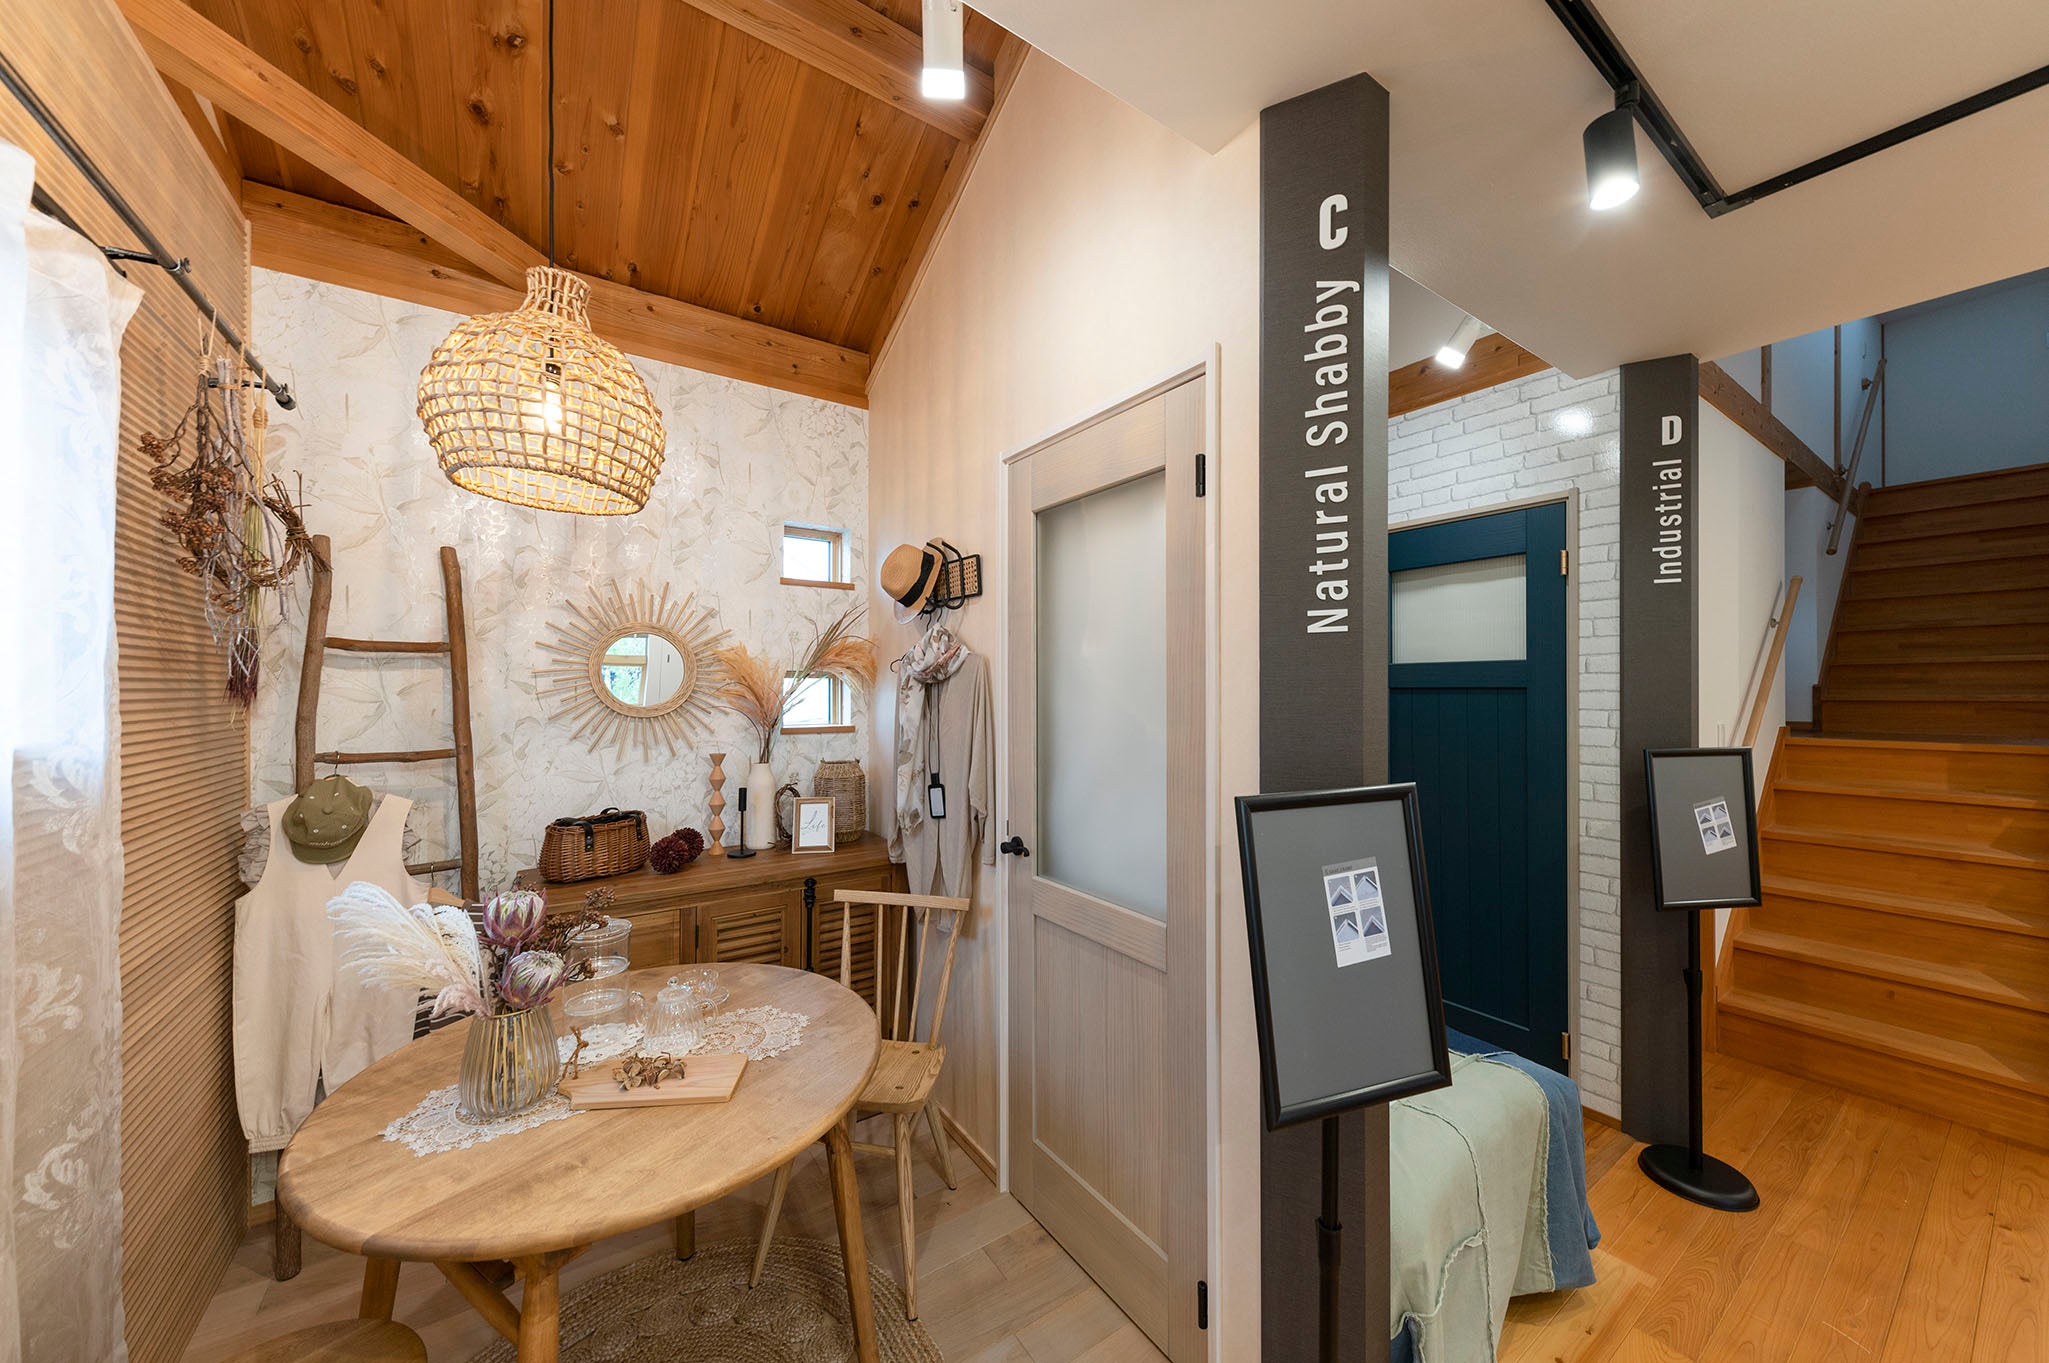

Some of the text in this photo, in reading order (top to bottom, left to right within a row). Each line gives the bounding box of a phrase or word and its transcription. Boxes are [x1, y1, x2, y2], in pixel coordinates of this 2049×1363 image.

[1319, 194, 1348, 250] C
[1304, 280, 1359, 633] Natural Shabby
[1661, 415, 1683, 446] D
[1652, 458, 1683, 584] Industrial
